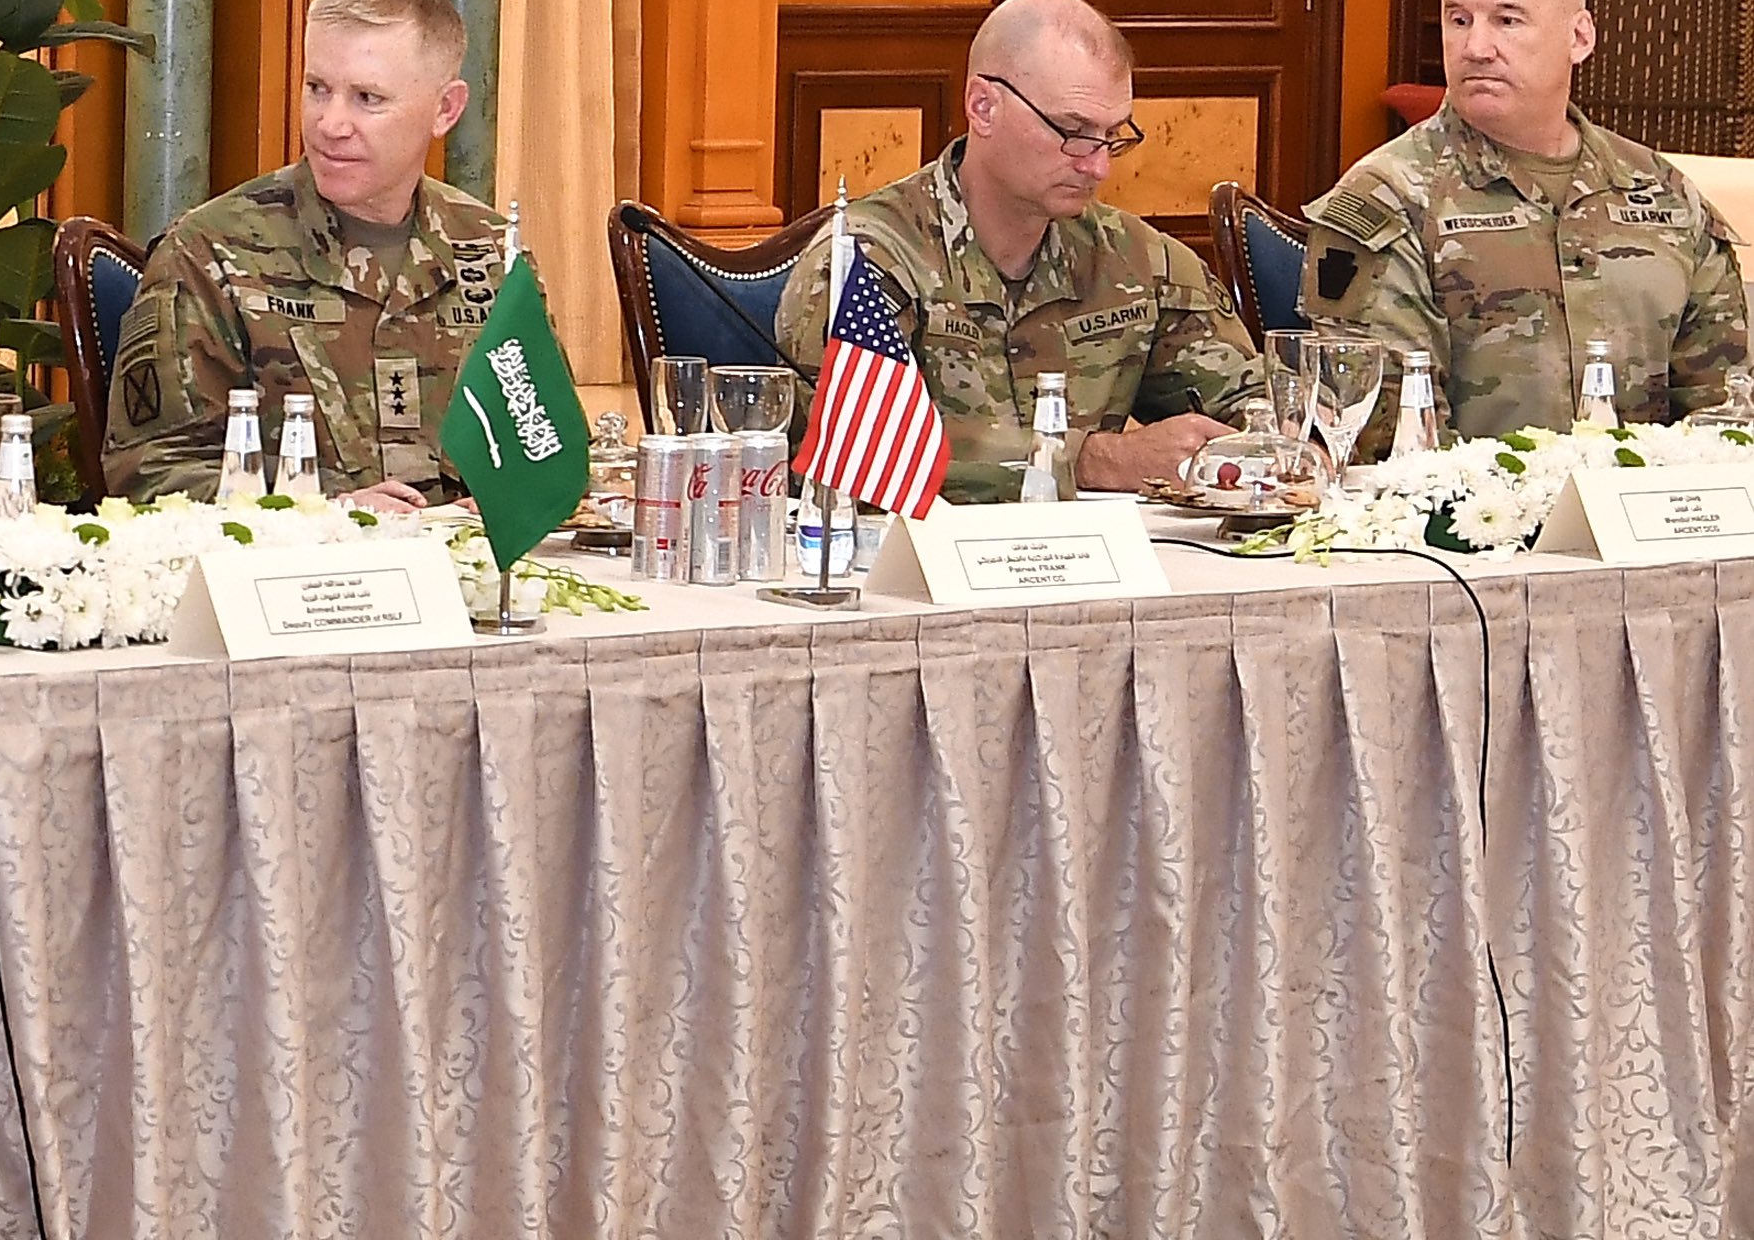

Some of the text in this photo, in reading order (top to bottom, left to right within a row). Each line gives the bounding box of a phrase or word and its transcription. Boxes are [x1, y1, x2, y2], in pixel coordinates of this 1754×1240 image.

[266, 295, 316, 320] FRANK
[282, 620, 312, 629] Deputy
[314, 615, 371, 627] COMMANDER
